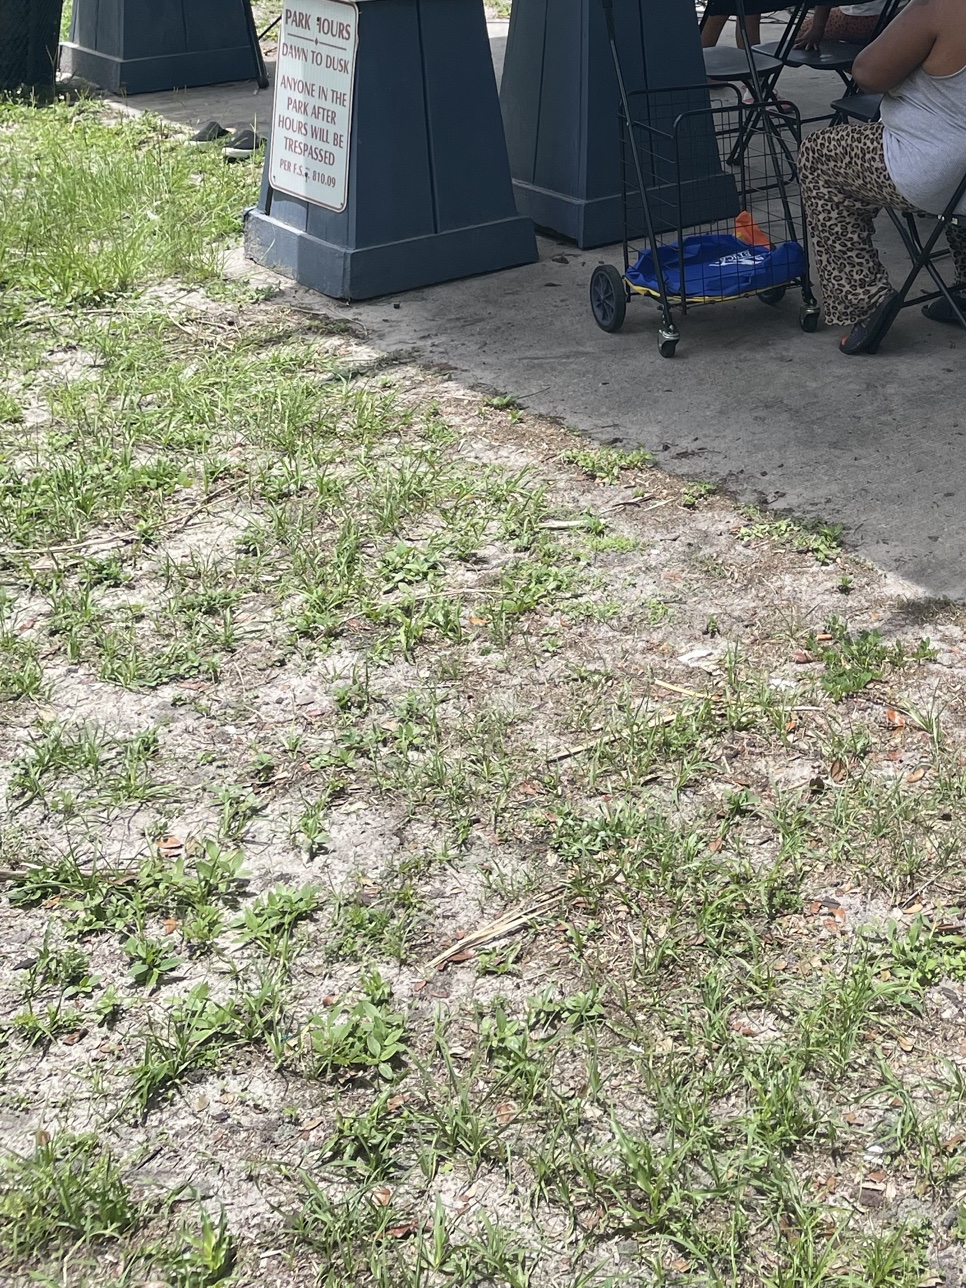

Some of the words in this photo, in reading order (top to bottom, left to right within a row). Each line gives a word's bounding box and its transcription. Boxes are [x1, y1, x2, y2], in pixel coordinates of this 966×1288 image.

[285, 8, 311, 31] PARK
[316, 16, 351, 41] HOURS
[282, 43, 308, 62] DAWN
[311, 50, 323, 66] TO
[325, 54, 349, 74] DUSK
[280, 75, 315, 98] ANYONE
[318, 85, 328, 101] IN
[331, 89, 347, 108] THE
[287, 97, 309, 116] PARK
[311, 104, 336, 125] AFTER
[278, 114, 308, 136] HOURS
[310, 124, 330, 144] WILL
[332, 132, 344, 149] BE
[284, 136, 335, 166] TRESPASSED
[279, 158, 291, 171] PER
[312, 170, 336, 188] 810.09
